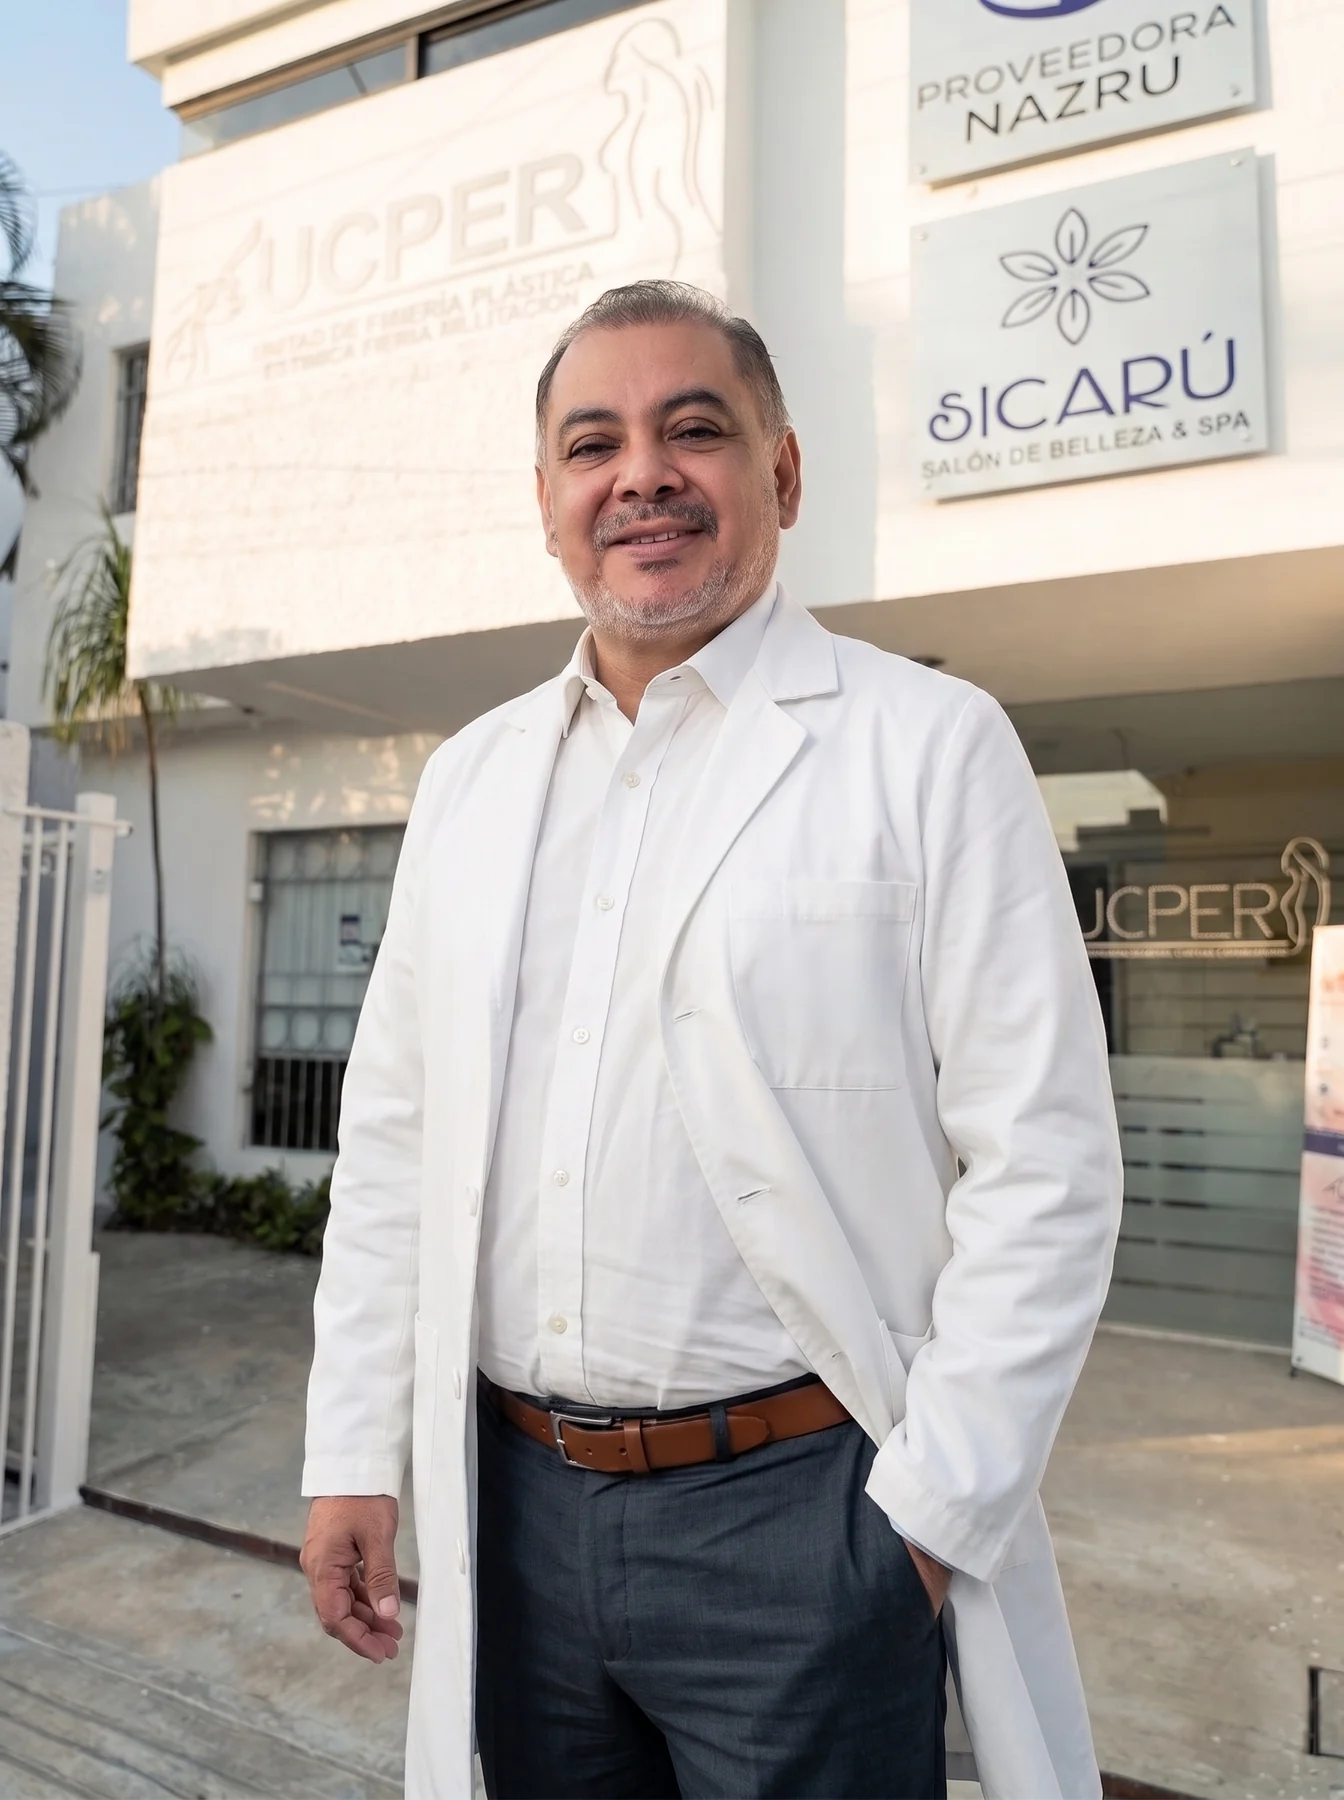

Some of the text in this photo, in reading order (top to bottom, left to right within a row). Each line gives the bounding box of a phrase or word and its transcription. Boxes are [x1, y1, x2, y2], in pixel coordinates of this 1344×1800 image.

[917, 4, 1236, 110] PROVEEDORA
[966, 55, 1180, 143] NAZRU
[260, 152, 589, 312] UCPER
[928, 332, 1236, 442] SICARÚ
[922, 411, 1250, 479] SALÓN DE BELLEZA & SPA
